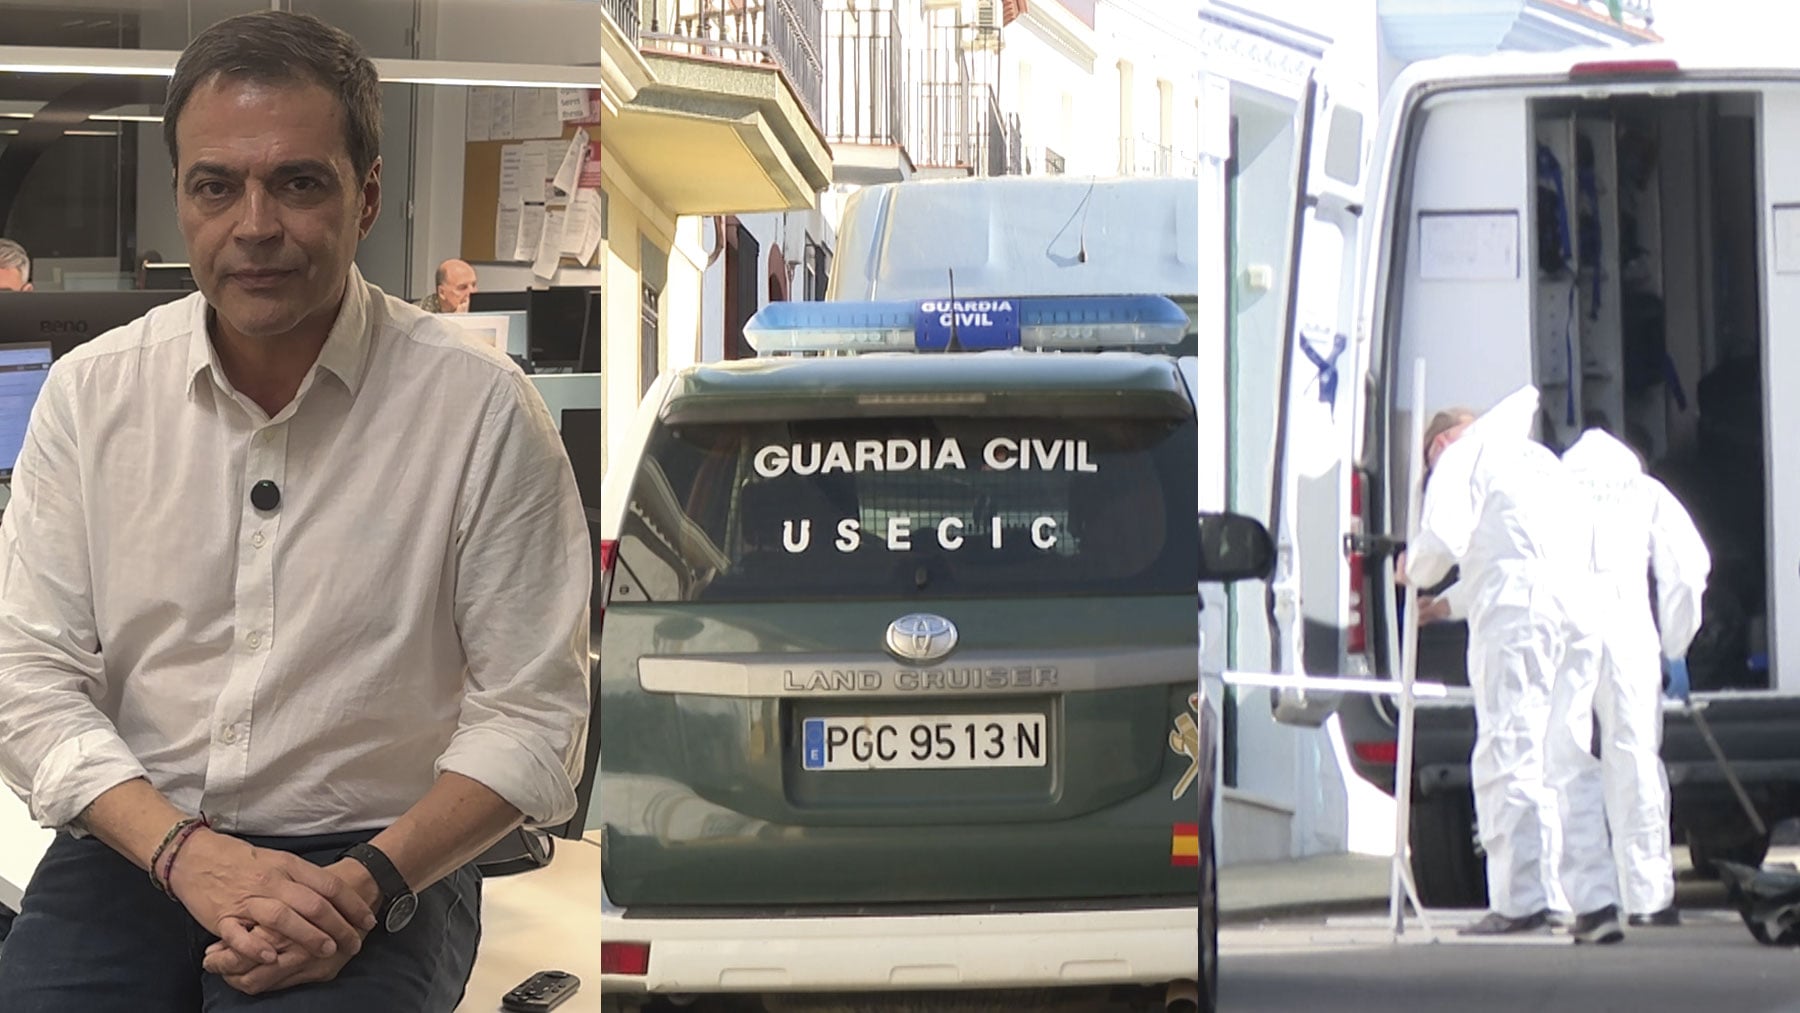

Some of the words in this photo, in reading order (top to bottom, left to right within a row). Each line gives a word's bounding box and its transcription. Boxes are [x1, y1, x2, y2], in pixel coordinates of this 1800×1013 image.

[921, 301, 1013, 313] GUARDIA
[939, 312, 994, 327] CIVIL
[753, 437, 966, 478] GUARDIA
[982, 437, 1099, 473] CIVIL
[783, 670, 882, 692] LAND
[894, 666, 1059, 690] CRUISER
[826, 725, 899, 763] PGC
[910, 722, 1006, 761] 9513
[1017, 722, 1041, 760] N
[810, 749, 819, 761] E
